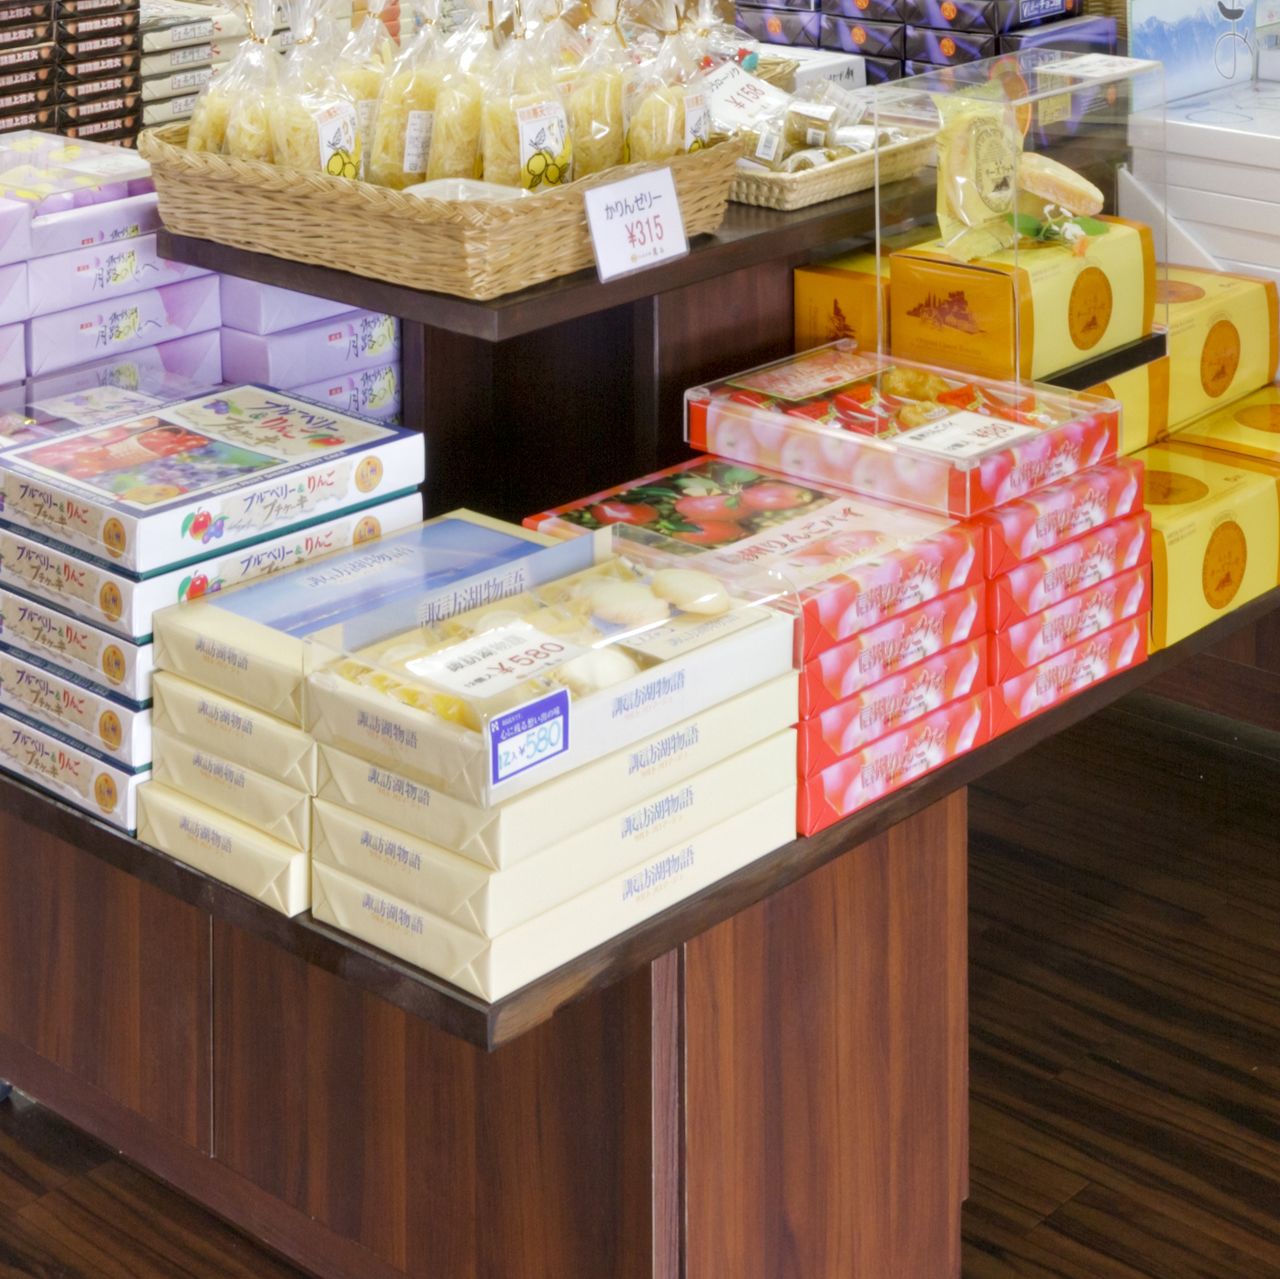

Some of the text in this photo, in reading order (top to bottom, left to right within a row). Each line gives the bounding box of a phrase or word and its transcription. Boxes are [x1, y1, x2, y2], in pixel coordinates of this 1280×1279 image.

[604, 192, 663, 221] かりんゼリー
[624, 214, 665, 248] ¥315
[245, 399, 339, 432] ブルーベリー
[194, 635, 249, 671] 諏訪湖物語
[487, 641, 565, 675] ¥580
[197, 701, 253, 736] 諏訪湖物語
[356, 710, 419, 750] 諏訪湖物語
[518, 719, 562, 761] ¥580
[192, 753, 247, 789] 諏訪湖物語
[366, 766, 432, 807] 諏訪湖物語
[179, 816, 233, 853] 諏訪湖物語
[359, 830, 423, 872] 諏訪湖物語
[361, 892, 424, 936] 諏訪湖物語
